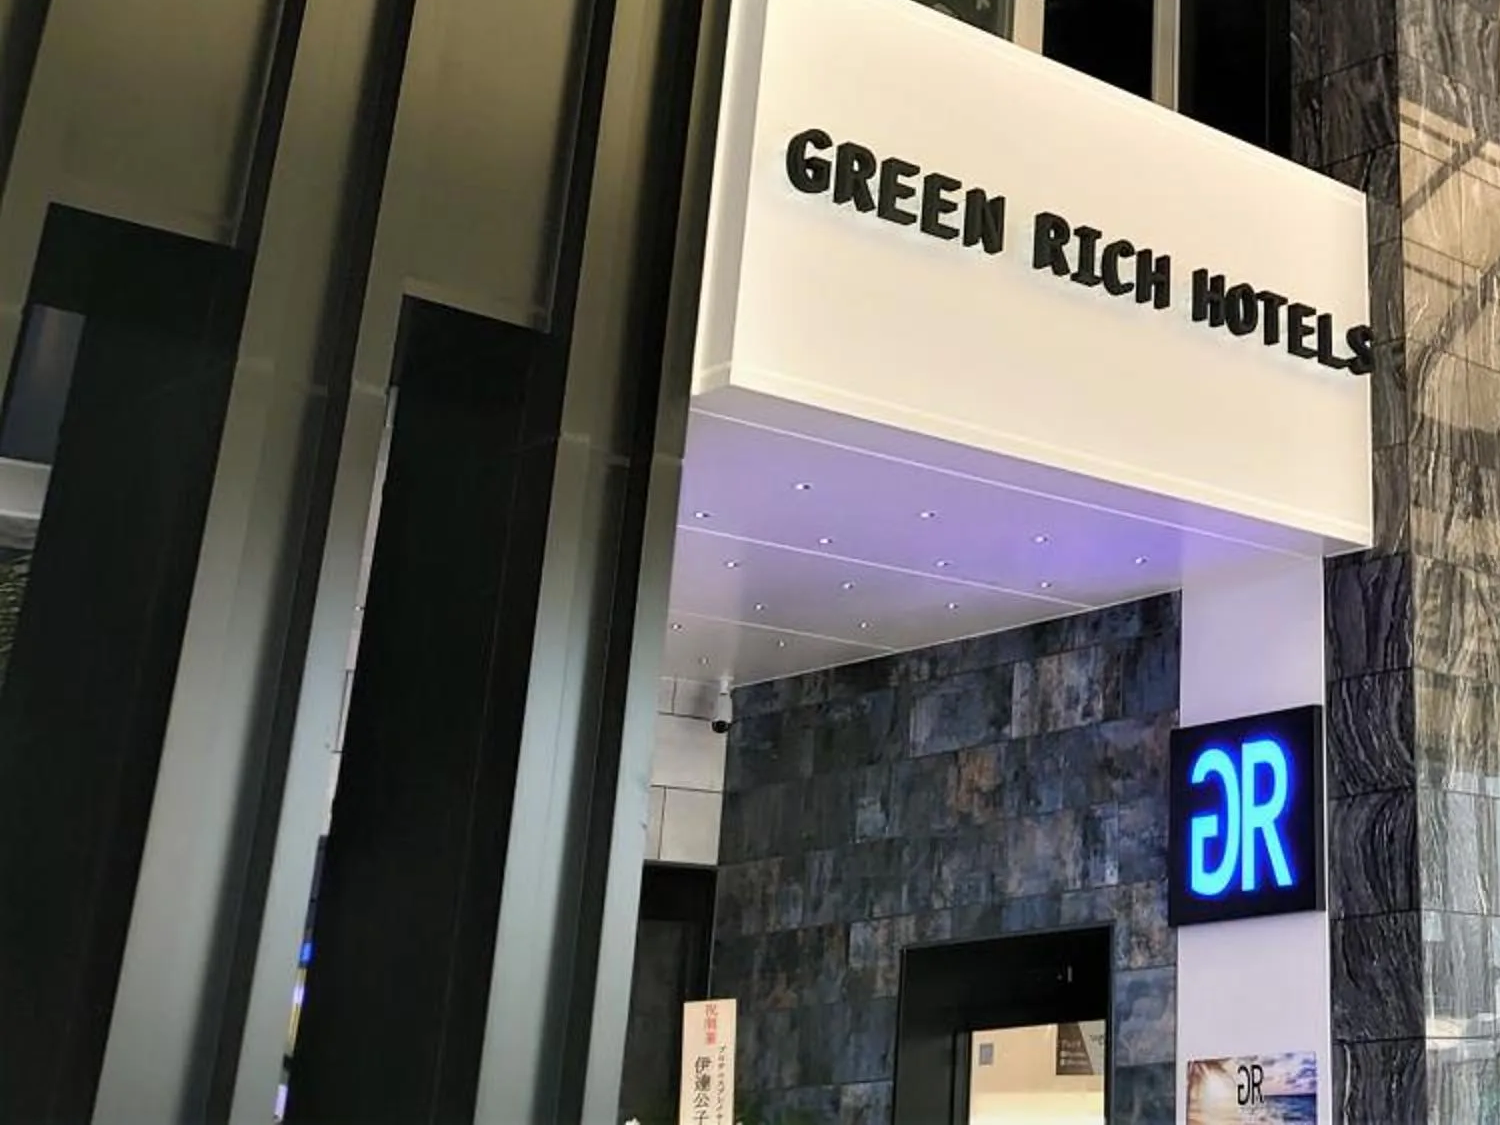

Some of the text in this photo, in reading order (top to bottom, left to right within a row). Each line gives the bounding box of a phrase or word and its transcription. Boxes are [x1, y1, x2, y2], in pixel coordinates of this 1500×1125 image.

[785, 128, 1375, 376] GREEN RICH HOTELS
